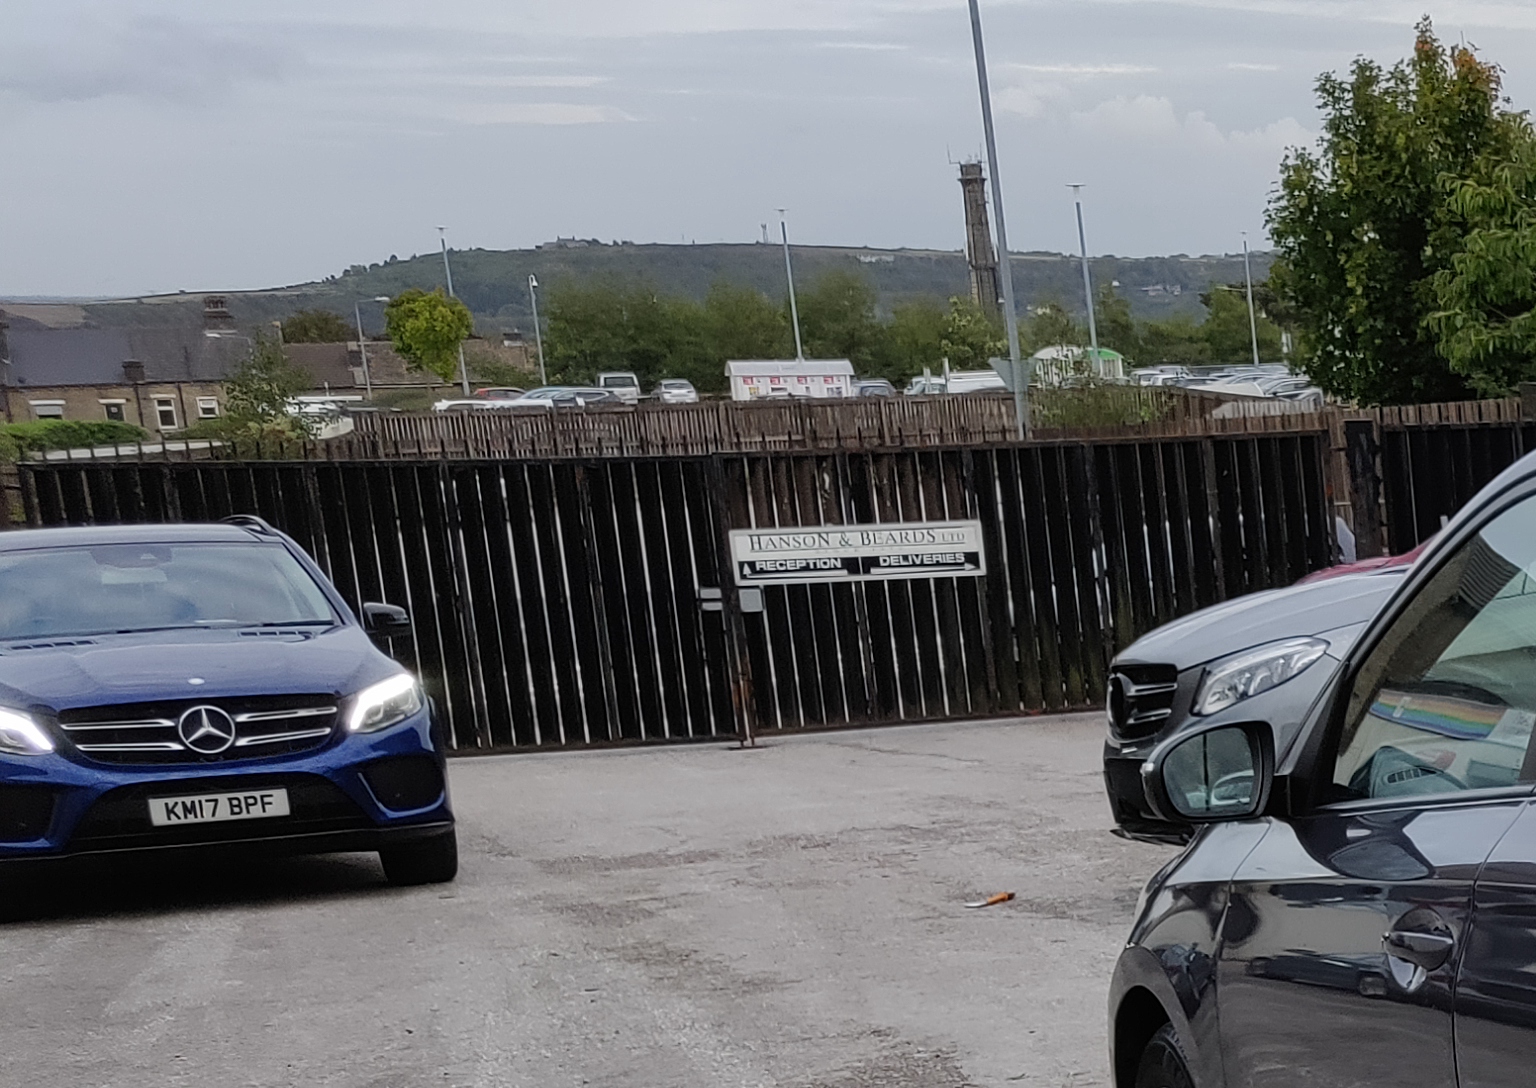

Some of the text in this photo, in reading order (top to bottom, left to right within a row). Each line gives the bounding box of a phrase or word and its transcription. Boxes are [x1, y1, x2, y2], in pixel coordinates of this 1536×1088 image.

[748, 531, 830, 551] HANSON
[838, 531, 853, 547] &
[860, 529, 936, 546] BEARDS
[942, 531, 966, 542] LTD
[755, 558, 842, 571] RECEPTION
[879, 553, 965, 567] DELIVERIES
[164, 794, 274, 821] KM17 BPF
